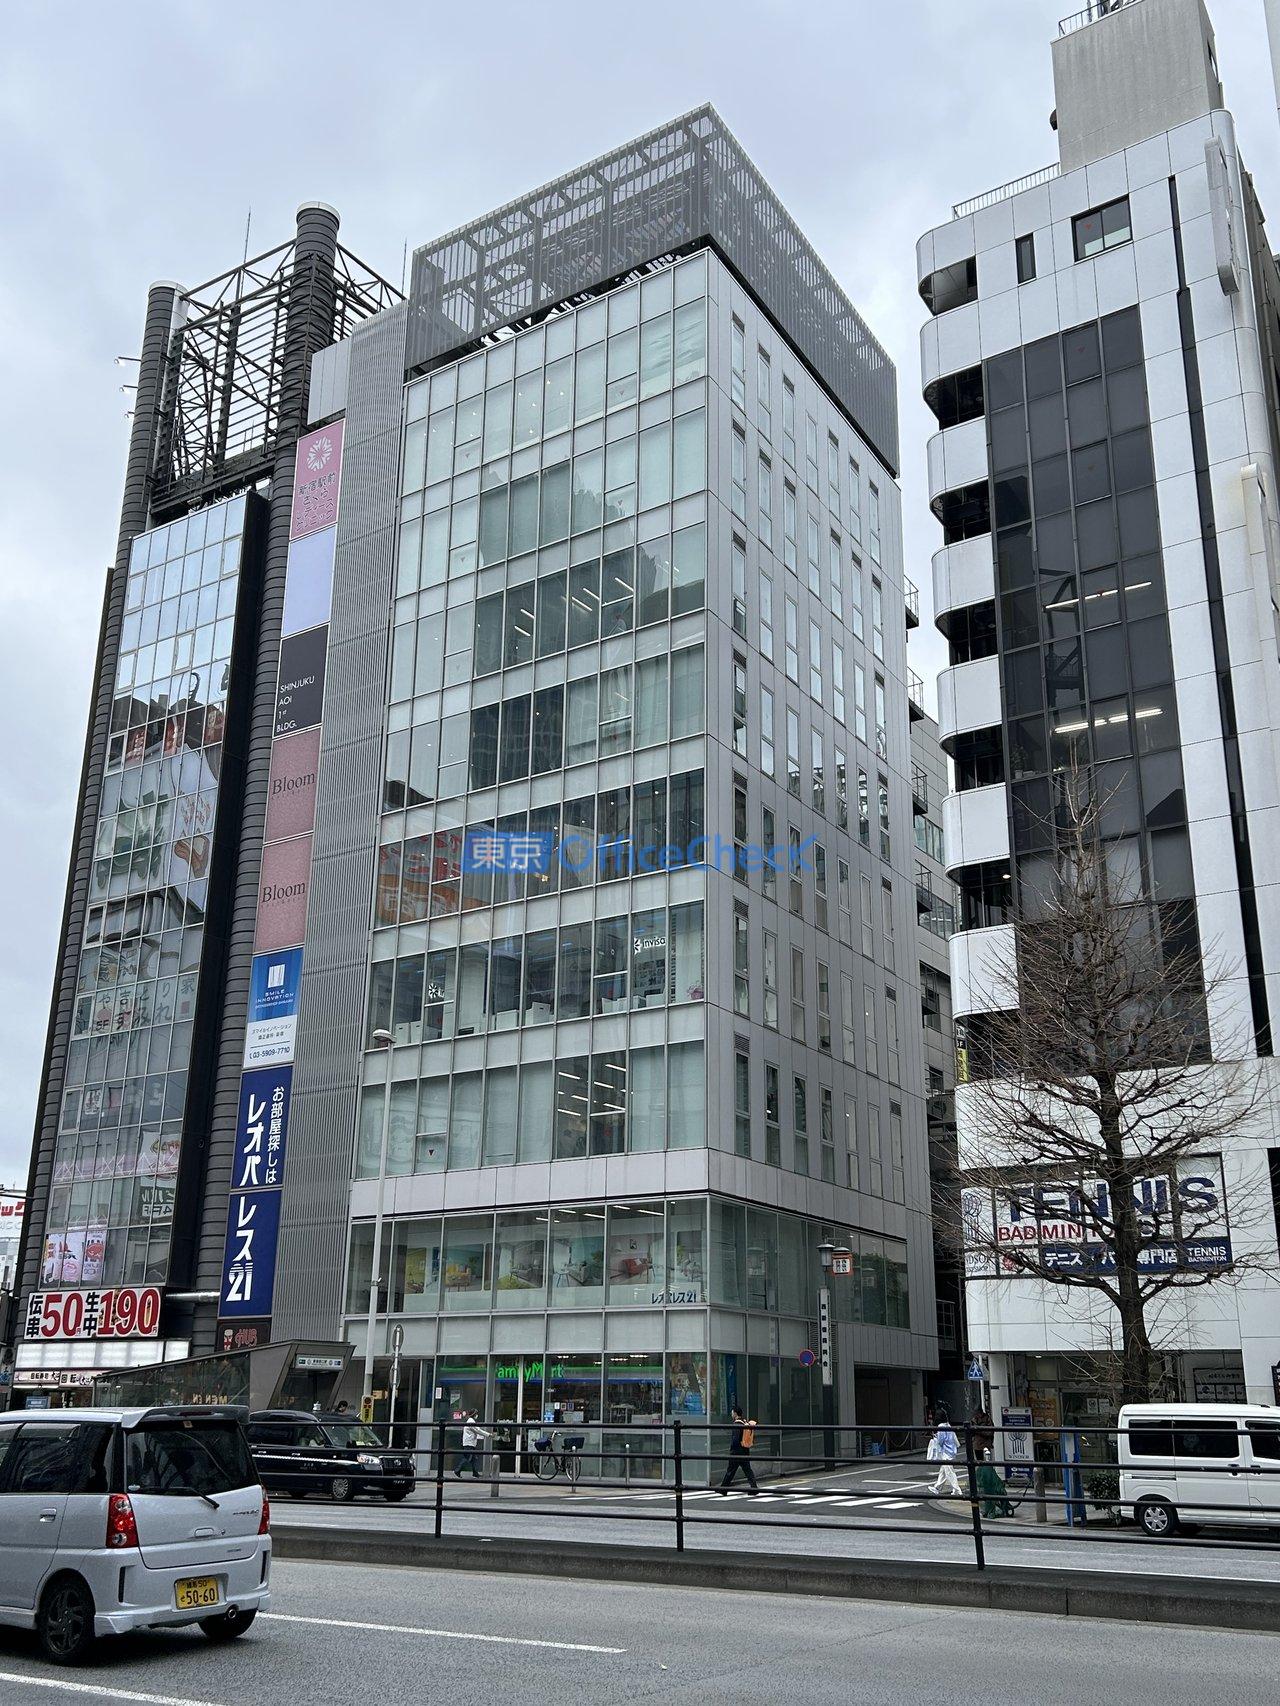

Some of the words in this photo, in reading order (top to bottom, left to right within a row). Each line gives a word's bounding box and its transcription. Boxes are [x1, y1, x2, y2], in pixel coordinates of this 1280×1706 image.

[280, 676, 315, 694] SHINJUKU
[279, 696, 292, 707] AOI
[271, 773, 315, 795] Bloom
[262, 882, 306, 903] Bloom
[265, 1086, 285, 1184] お部屋探しは
[1188, 1246, 1227, 1257] TENNIS
[26, 1294, 43, 1337] 伝串
[83, 1292, 100, 1336] 生中
[186, 1588, 215, 1605] 50-60
